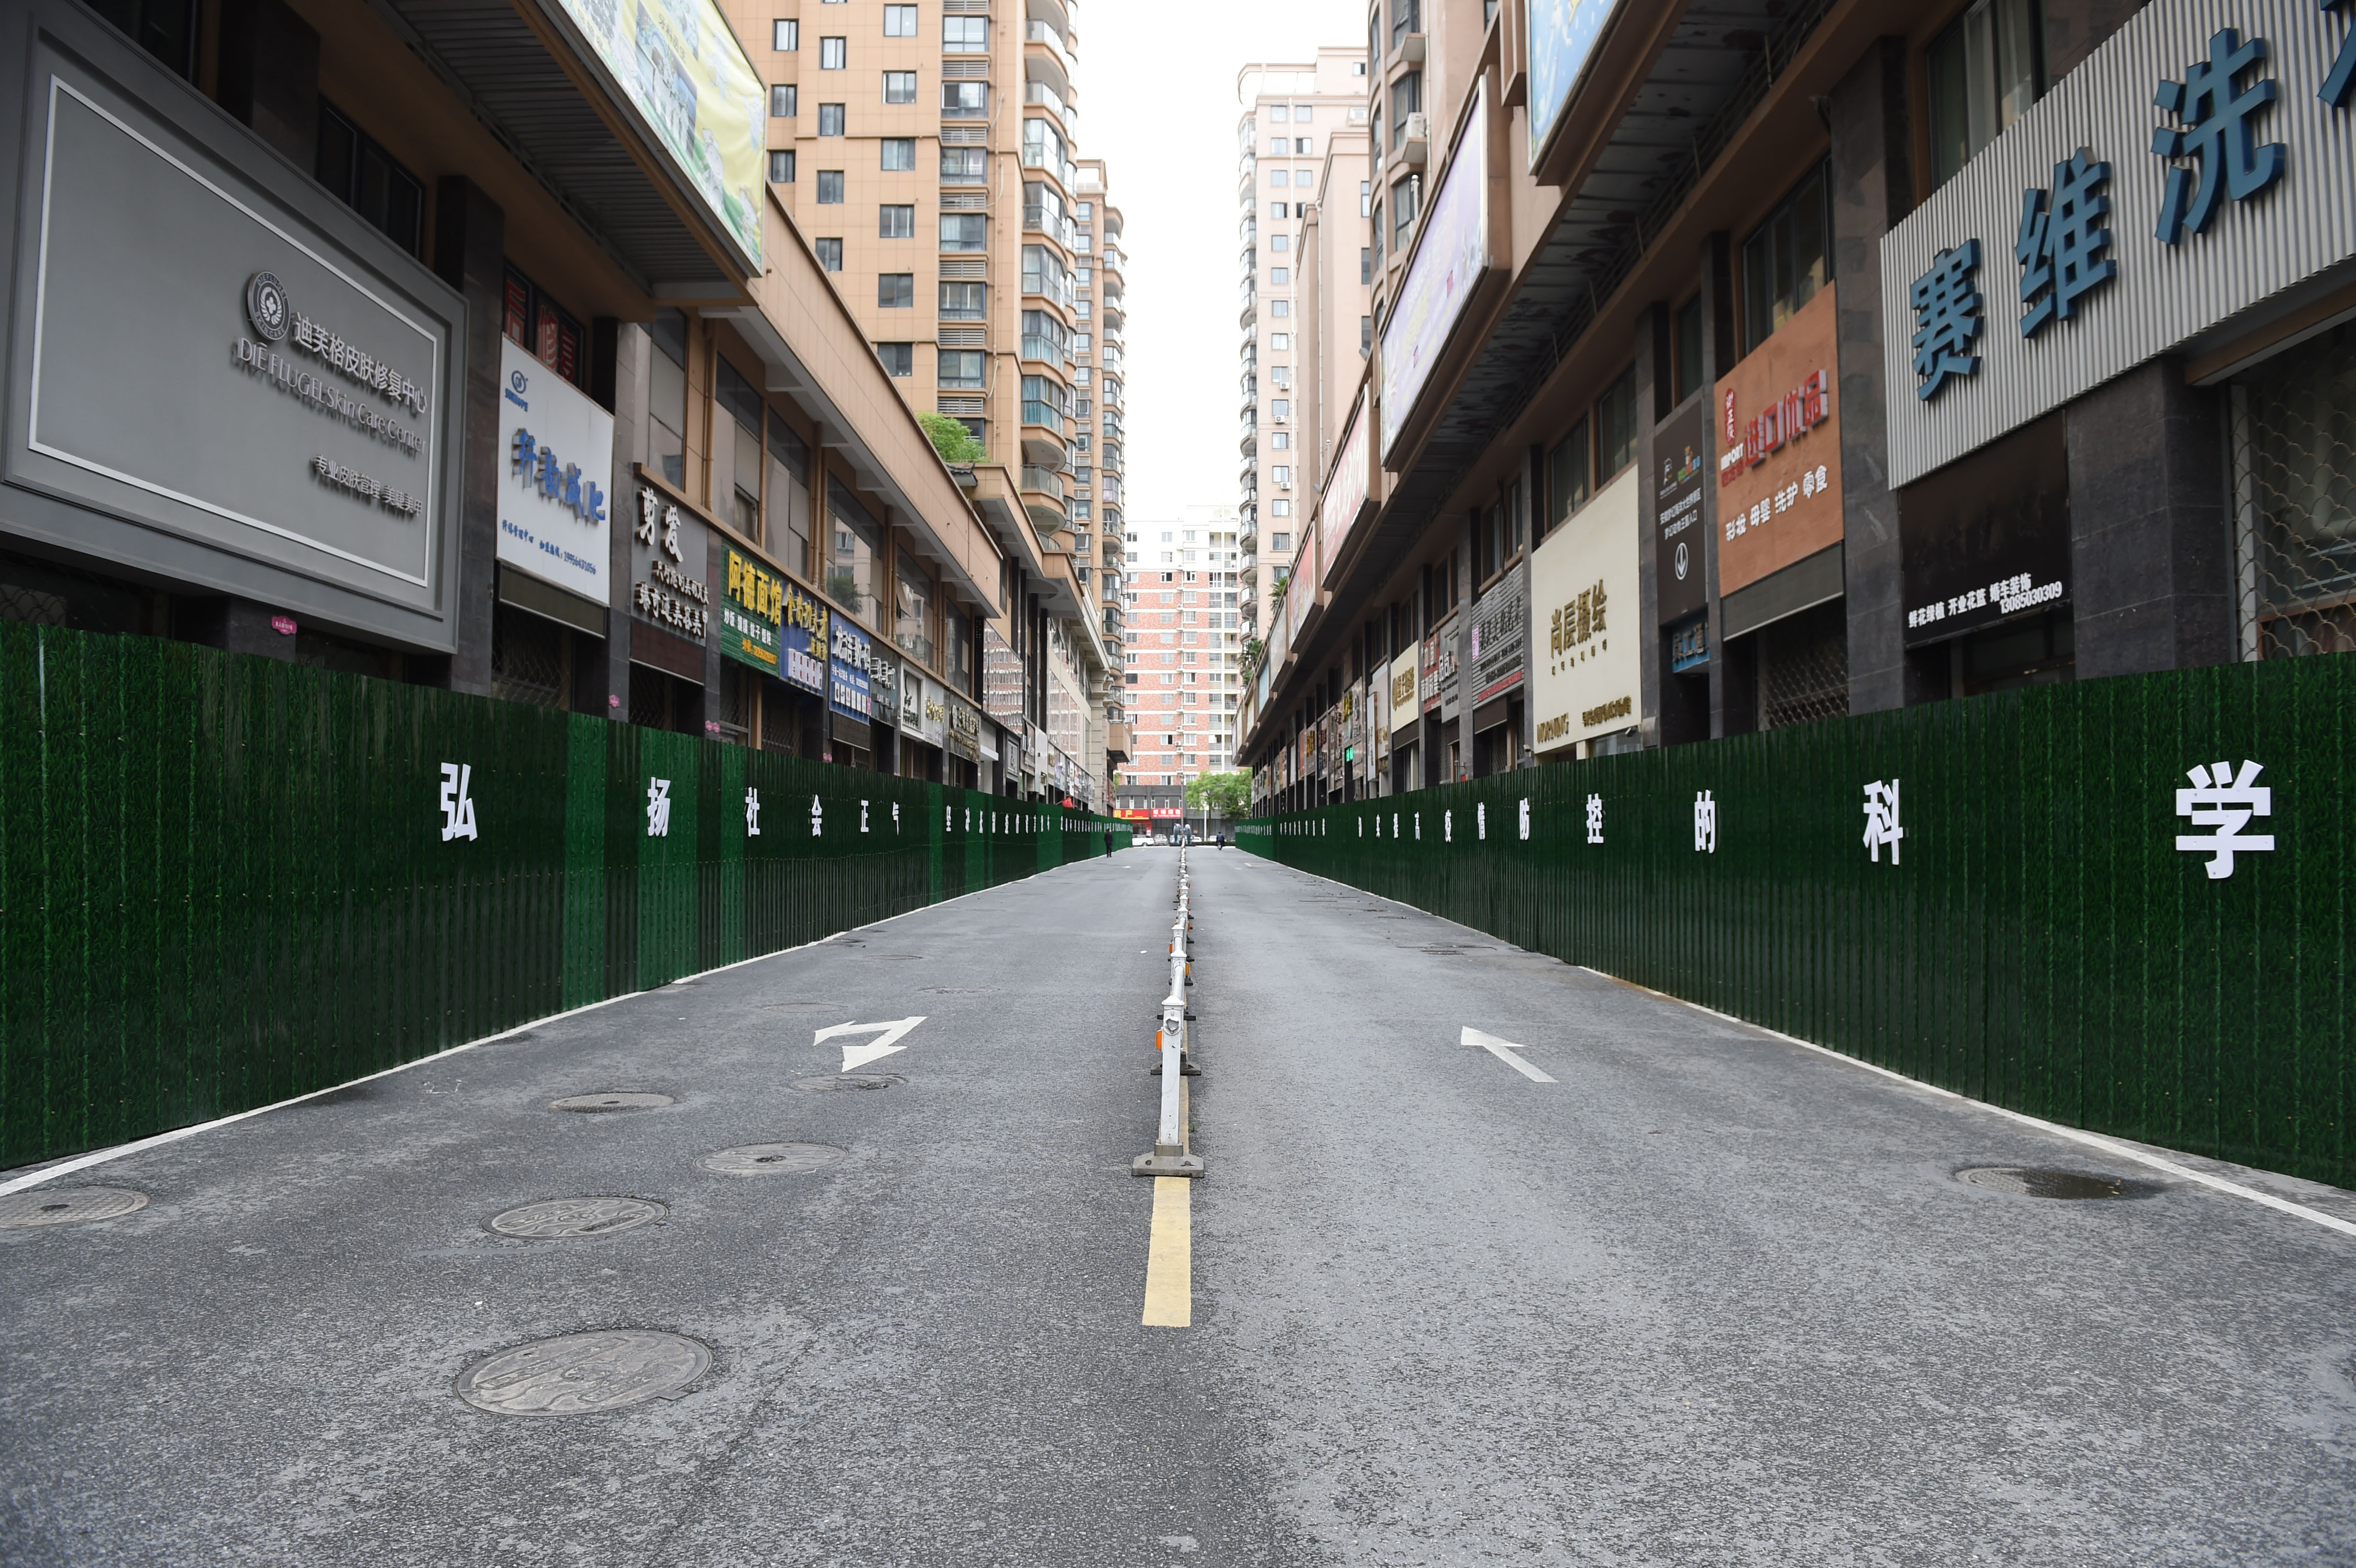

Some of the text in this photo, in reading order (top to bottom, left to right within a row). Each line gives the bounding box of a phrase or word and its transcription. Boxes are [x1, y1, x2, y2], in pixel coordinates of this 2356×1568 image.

[293, 312, 428, 414] 迪芙格皮肤修复中心
[327, 385, 355, 418] Skin
[358, 403, 385, 434] Care
[387, 418, 426, 454] Center
[1745, 369, 1828, 468] 进口优品
[315, 454, 423, 517] 专业皮肤管理 美睫美甲
[1721, 443, 1745, 471] IMPORT
[1724, 465, 1829, 542] 彩妆 母婴 洗护 零食
[728, 550, 783, 627] 阿德面馆
[1908, 572, 2032, 629] 鲜花绿植 开业花篮 婚车装饰
[1999, 580, 2063, 615] 13085030309
